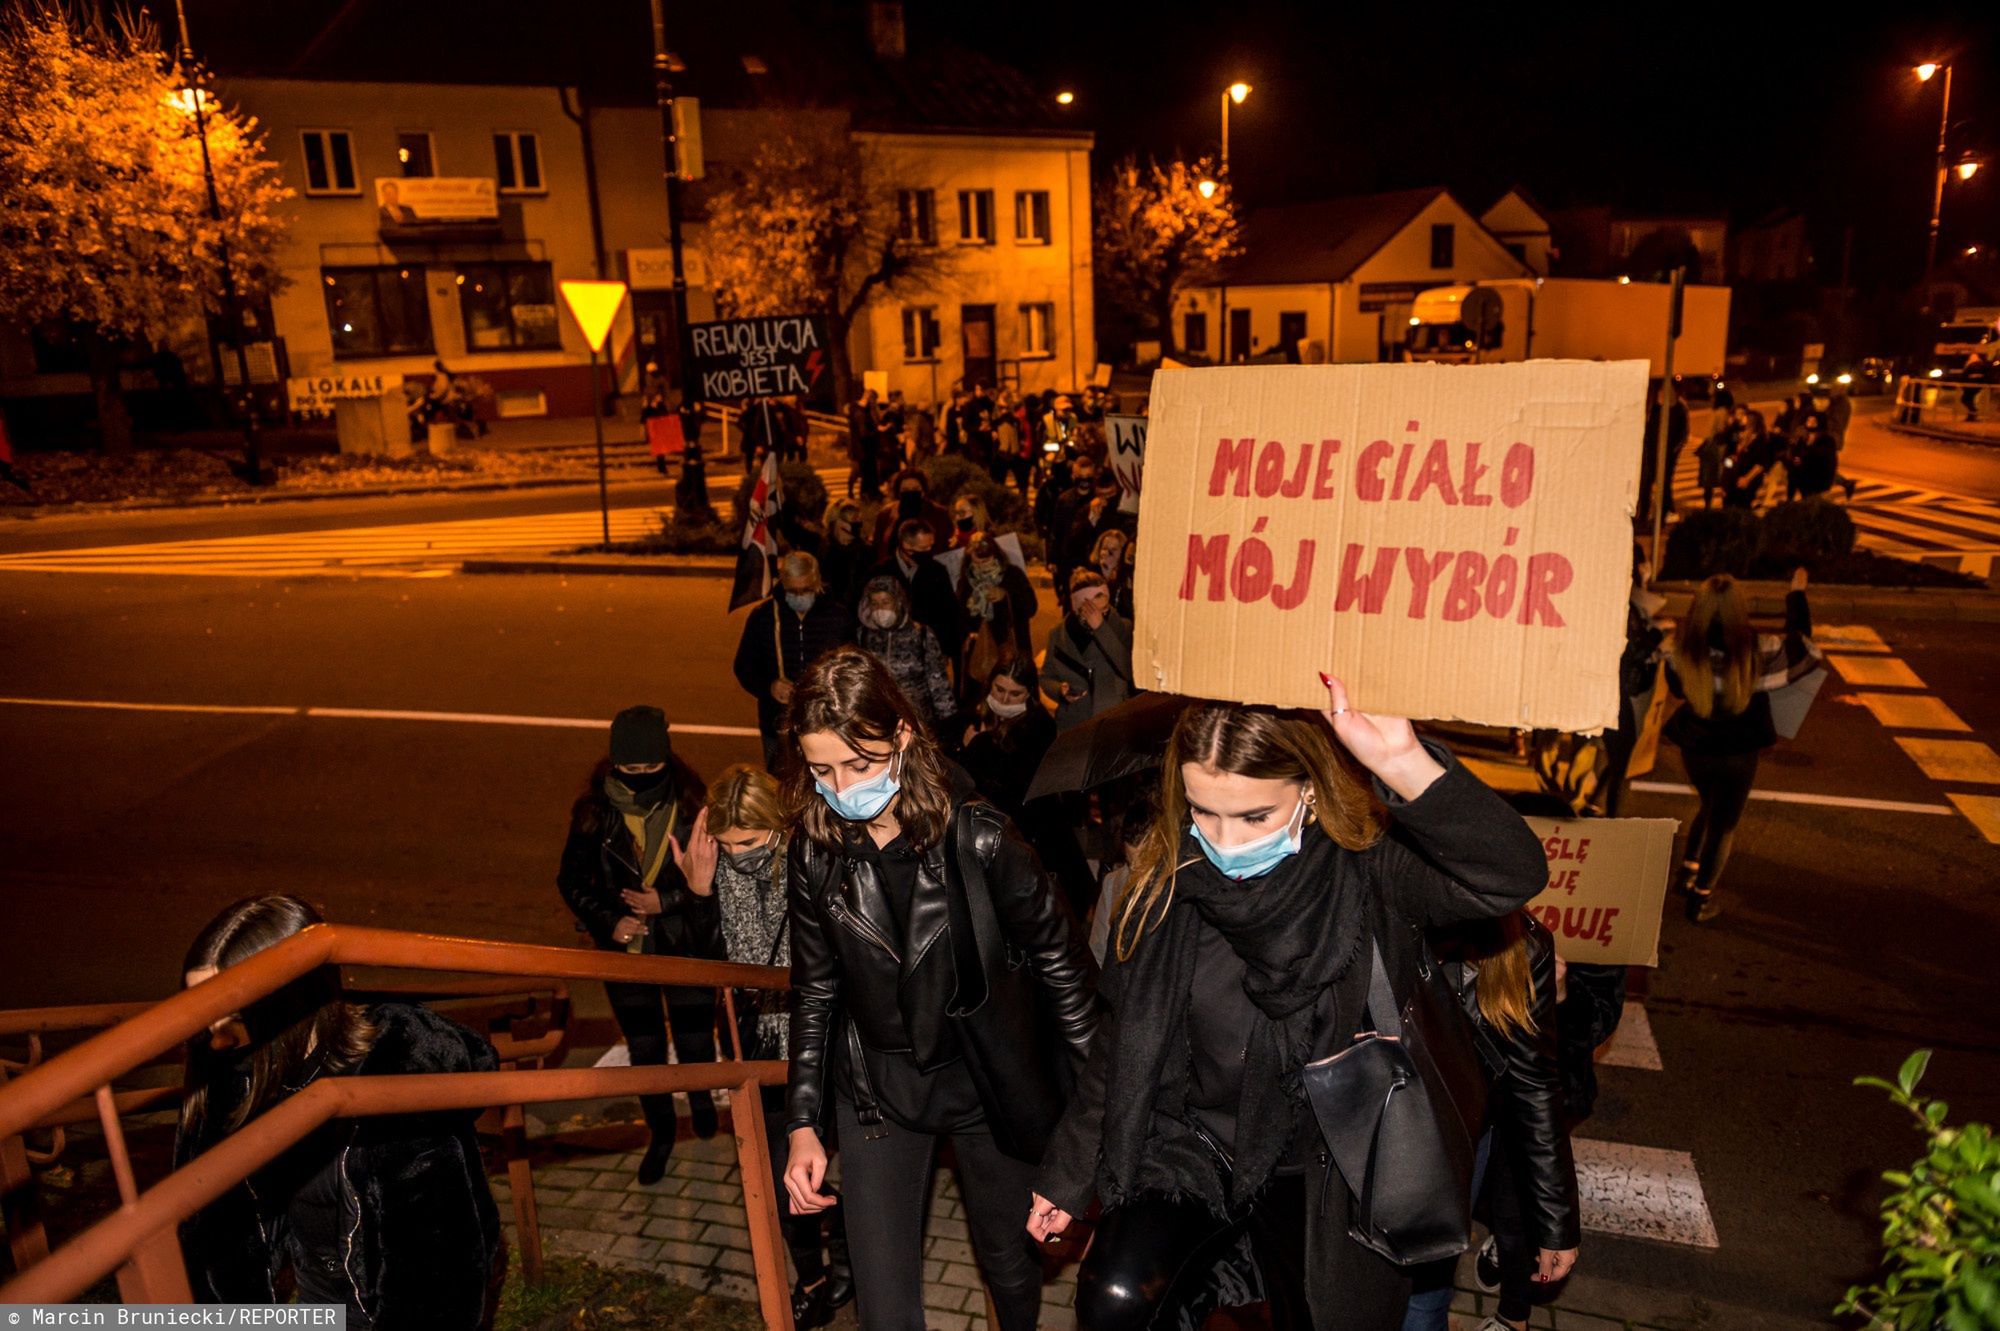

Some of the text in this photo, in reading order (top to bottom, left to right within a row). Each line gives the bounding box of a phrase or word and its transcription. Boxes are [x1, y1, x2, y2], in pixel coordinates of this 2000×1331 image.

[692, 318, 818, 357] REWOLUCJA
[740, 347, 776, 367] JEST
[1208, 438, 1341, 500] MOJE
[1178, 516, 1574, 628] MÓJ WYBÓR
[1539, 826, 1591, 864] ŚLĘ
[1549, 870, 1580, 896] JĘ
